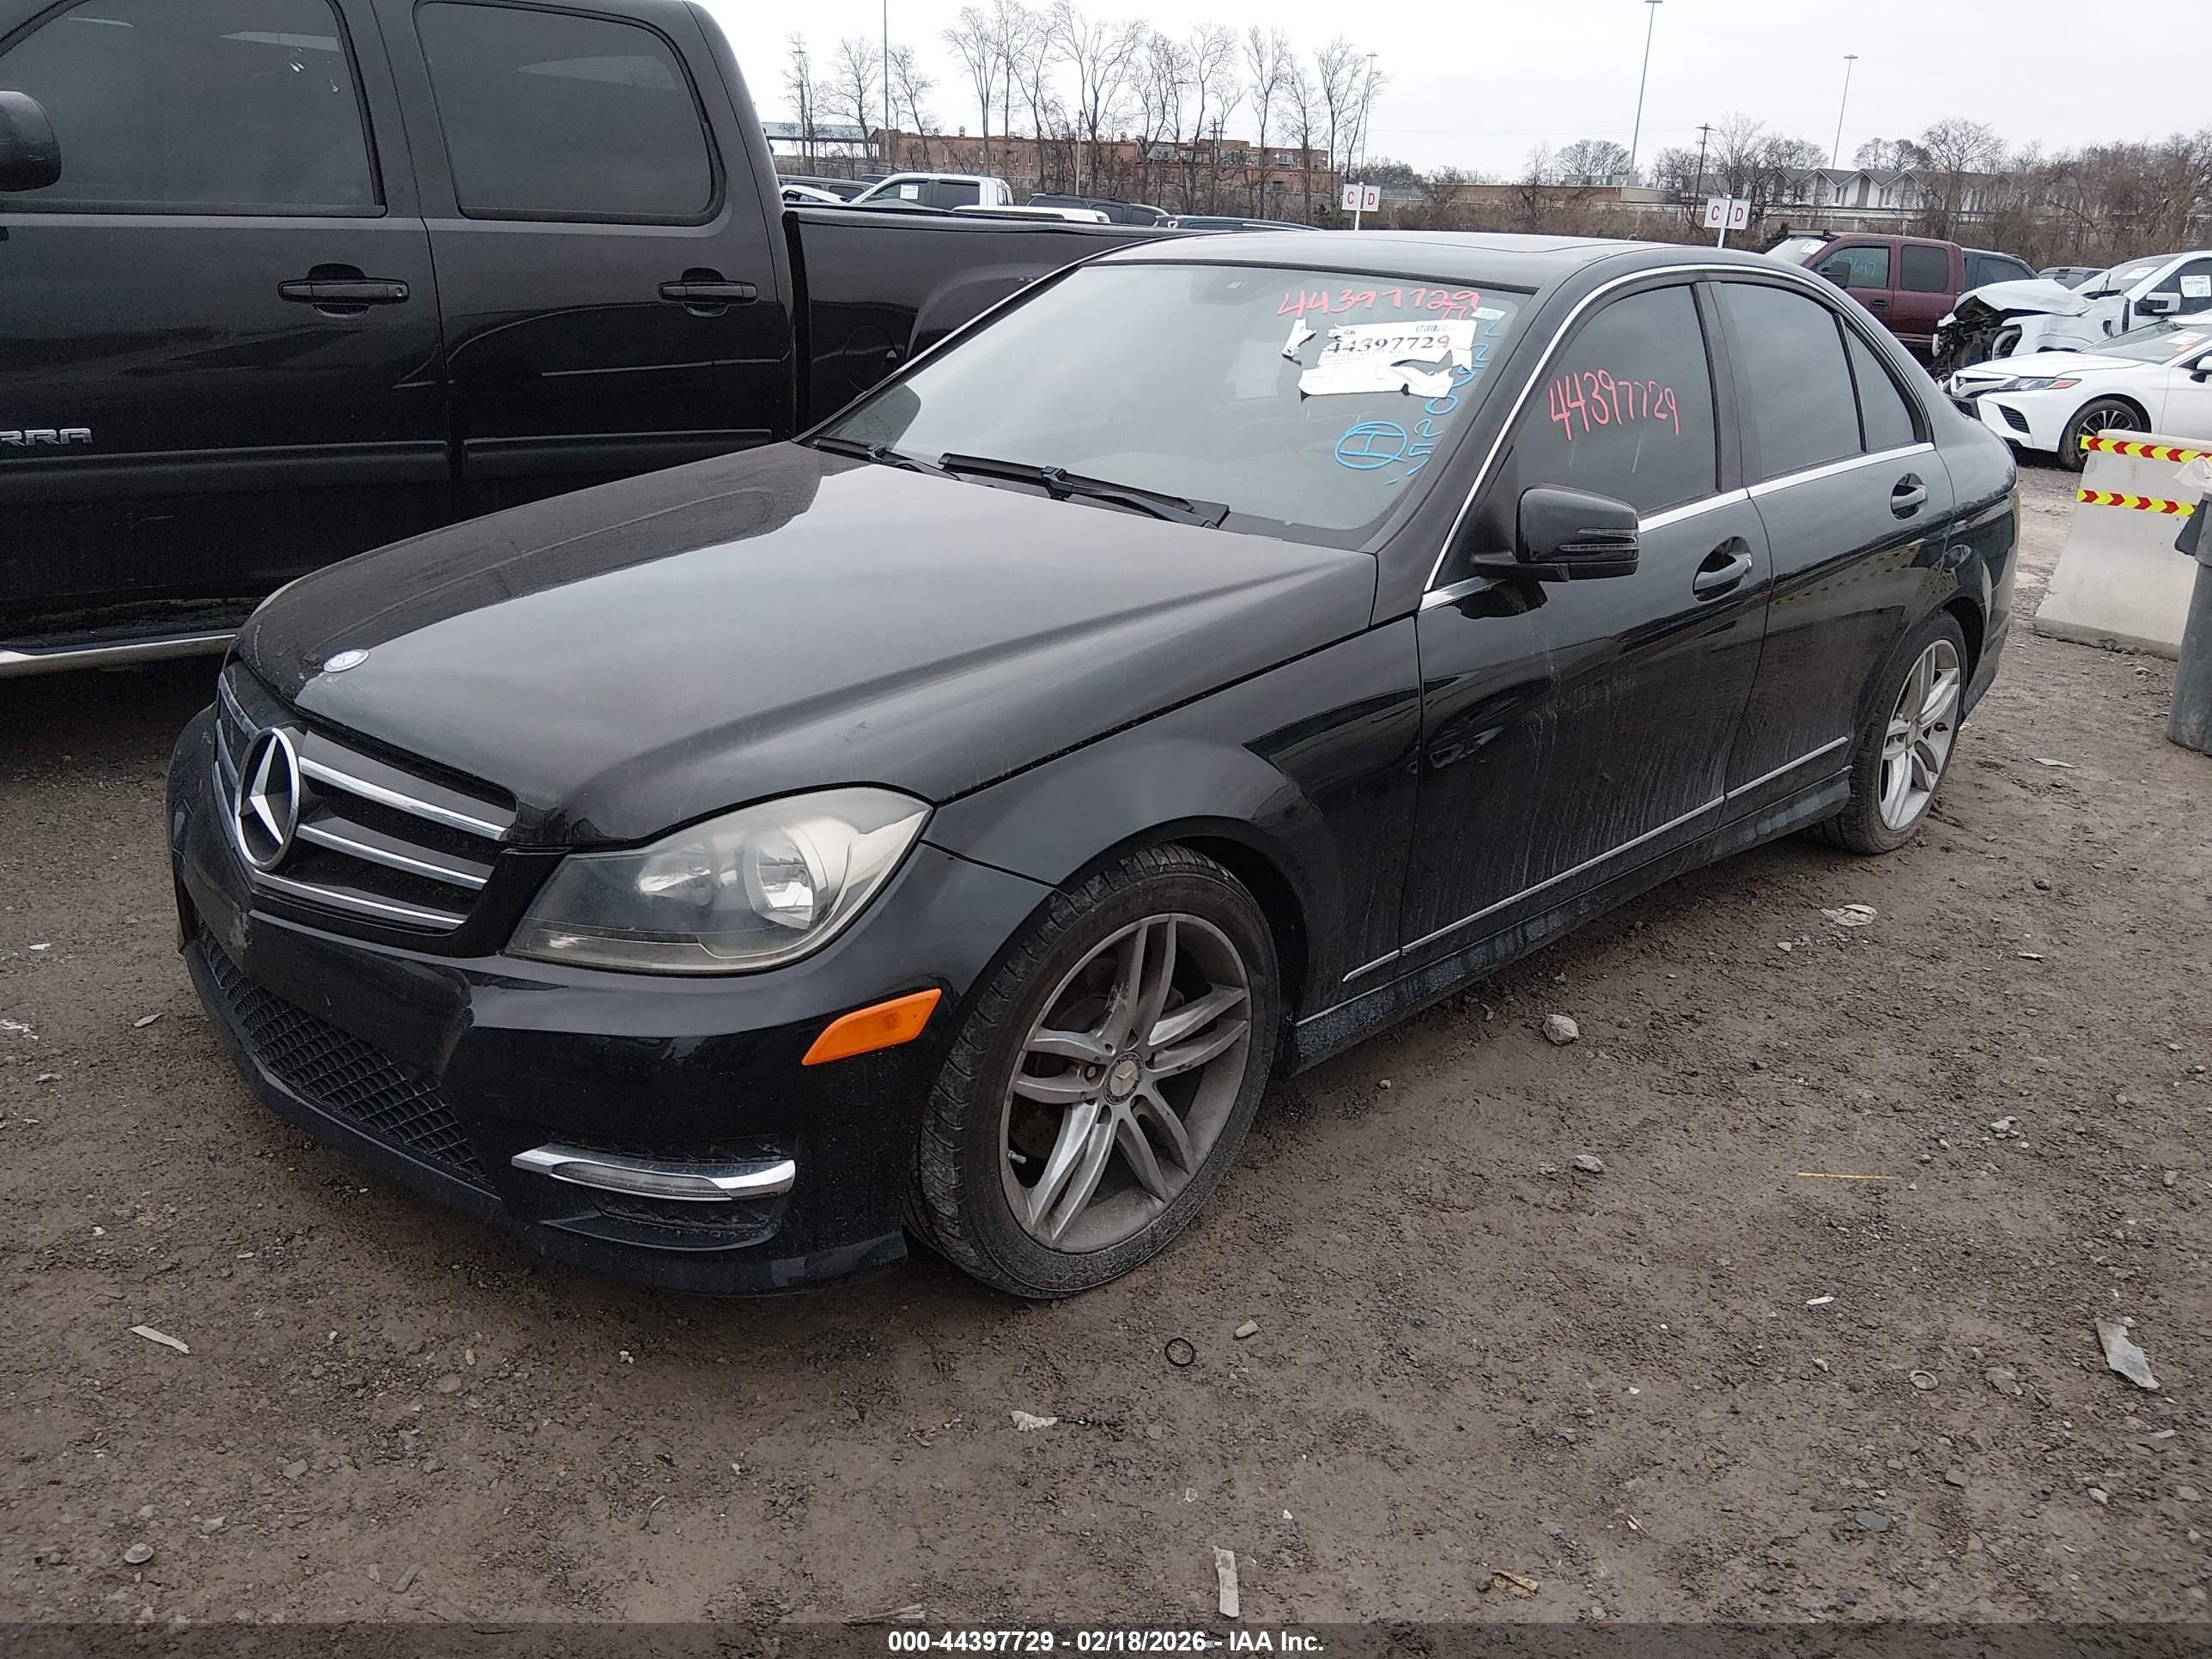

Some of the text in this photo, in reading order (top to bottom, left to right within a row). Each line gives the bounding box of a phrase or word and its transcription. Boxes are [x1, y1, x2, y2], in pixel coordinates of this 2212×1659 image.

[1346, 191, 1376, 206] C D
[1711, 204, 1744, 222] C D
[1328, 335, 1450, 353] 44397729
[1549, 369, 1680, 441] 44397729
